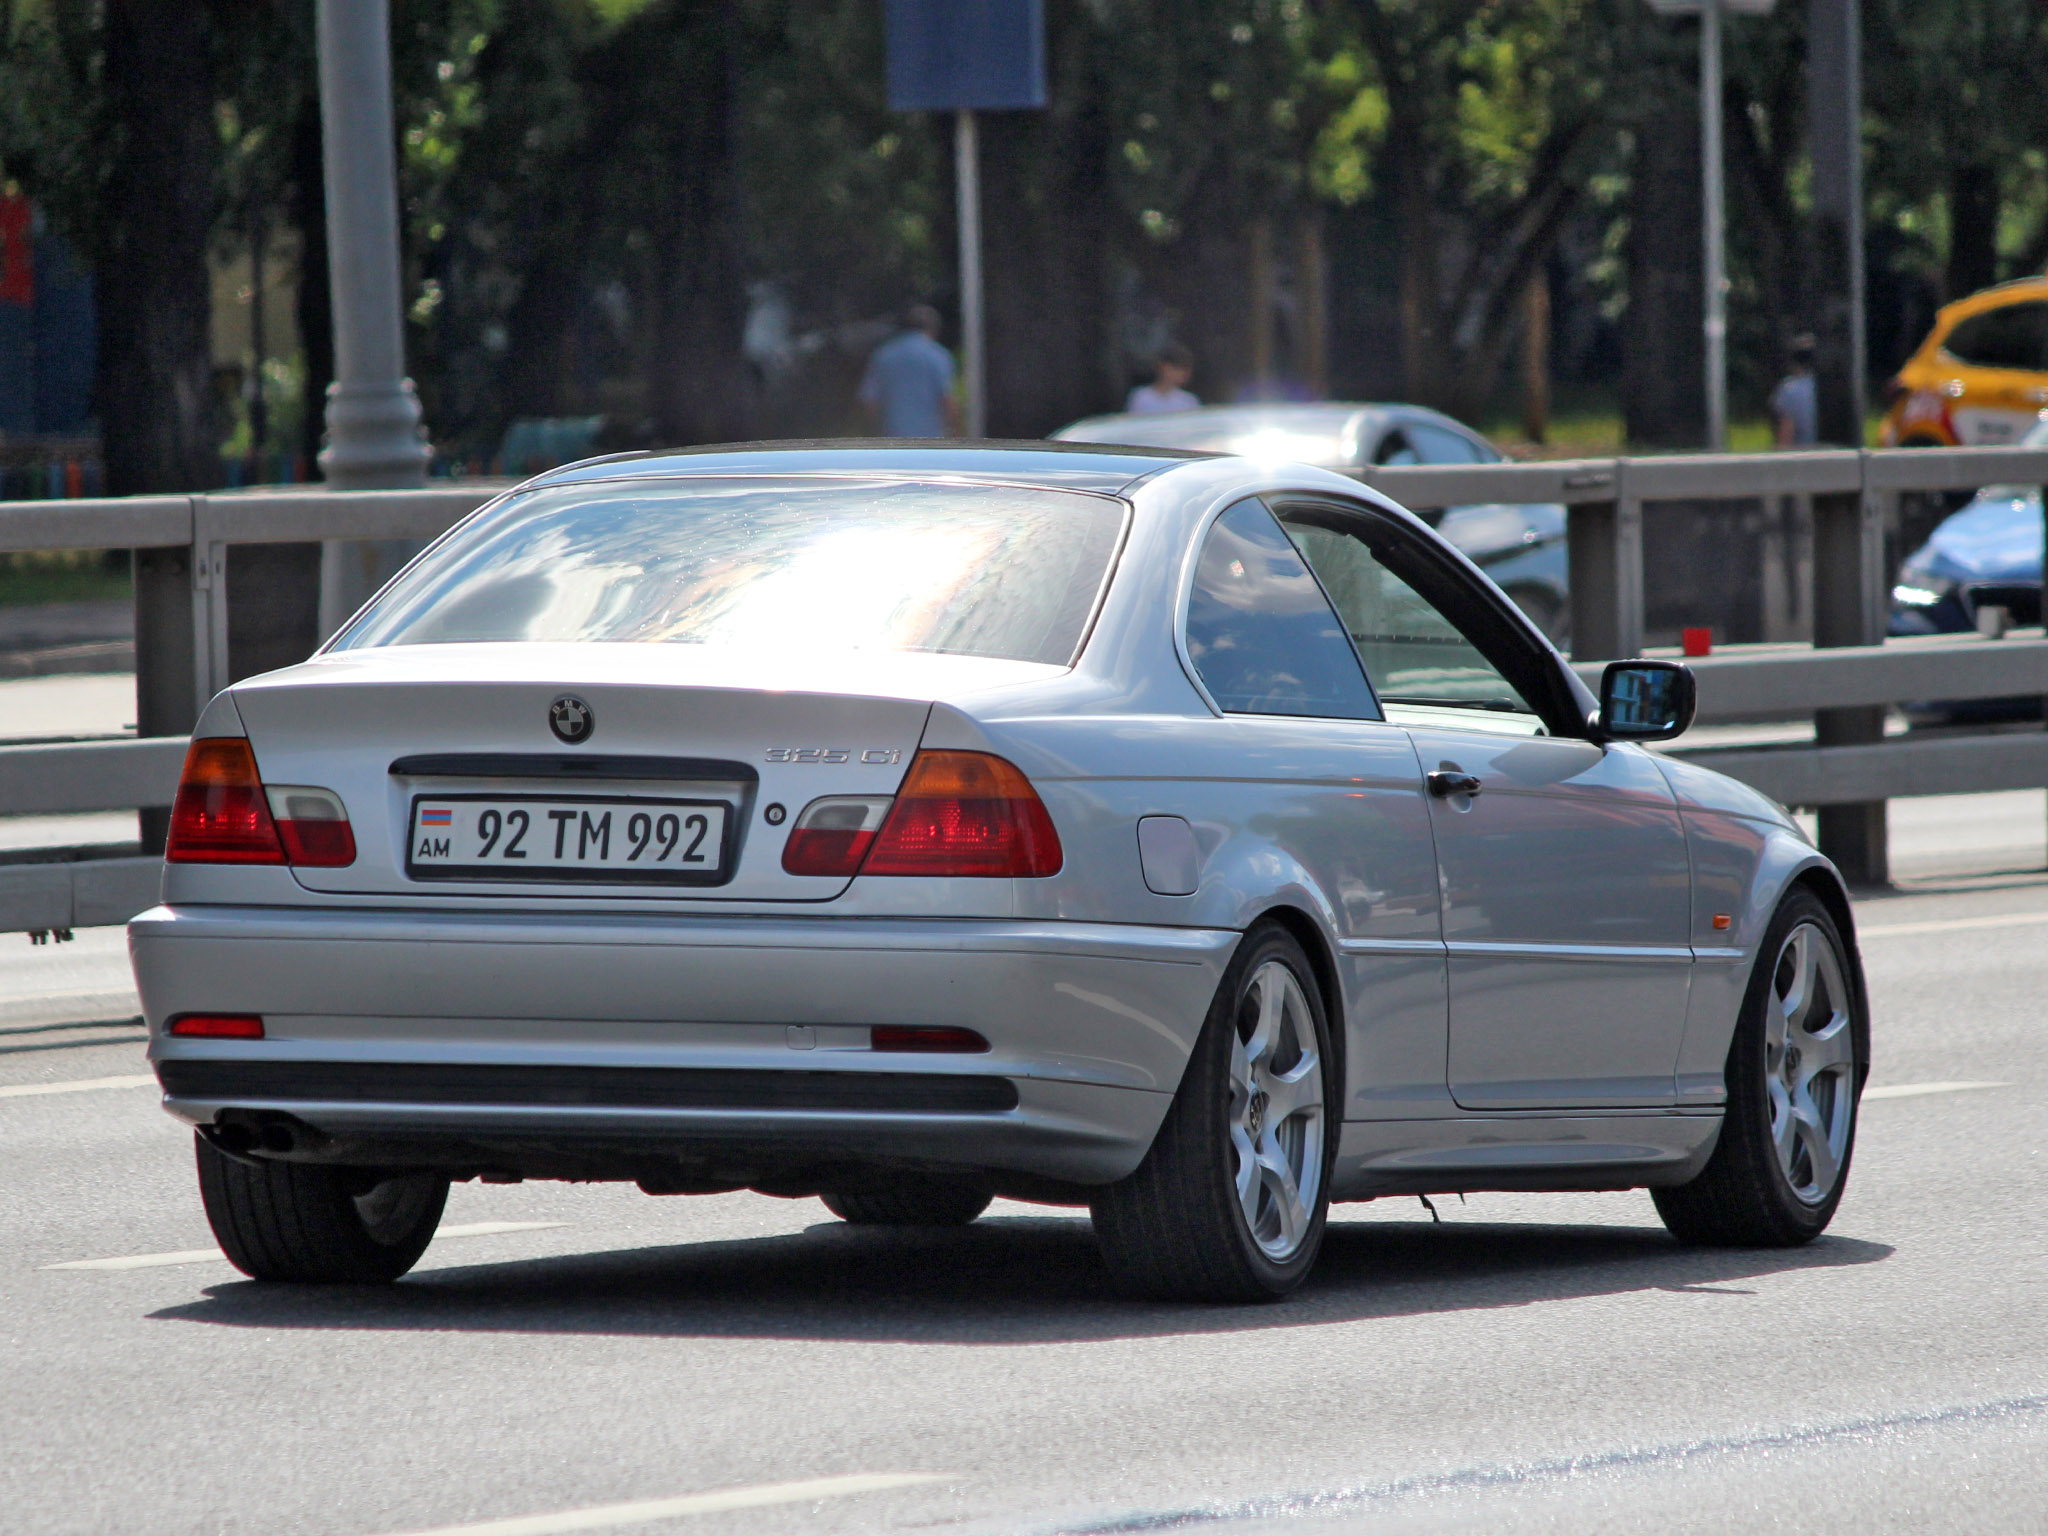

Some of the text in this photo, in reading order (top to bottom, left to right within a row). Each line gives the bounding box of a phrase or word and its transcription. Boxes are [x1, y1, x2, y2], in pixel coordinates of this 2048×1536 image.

[552, 700, 587, 714] BMW
[765, 747, 901, 764] 325 Ci
[476, 809, 708, 862] 92 TM 992
[417, 838, 450, 858] AM
